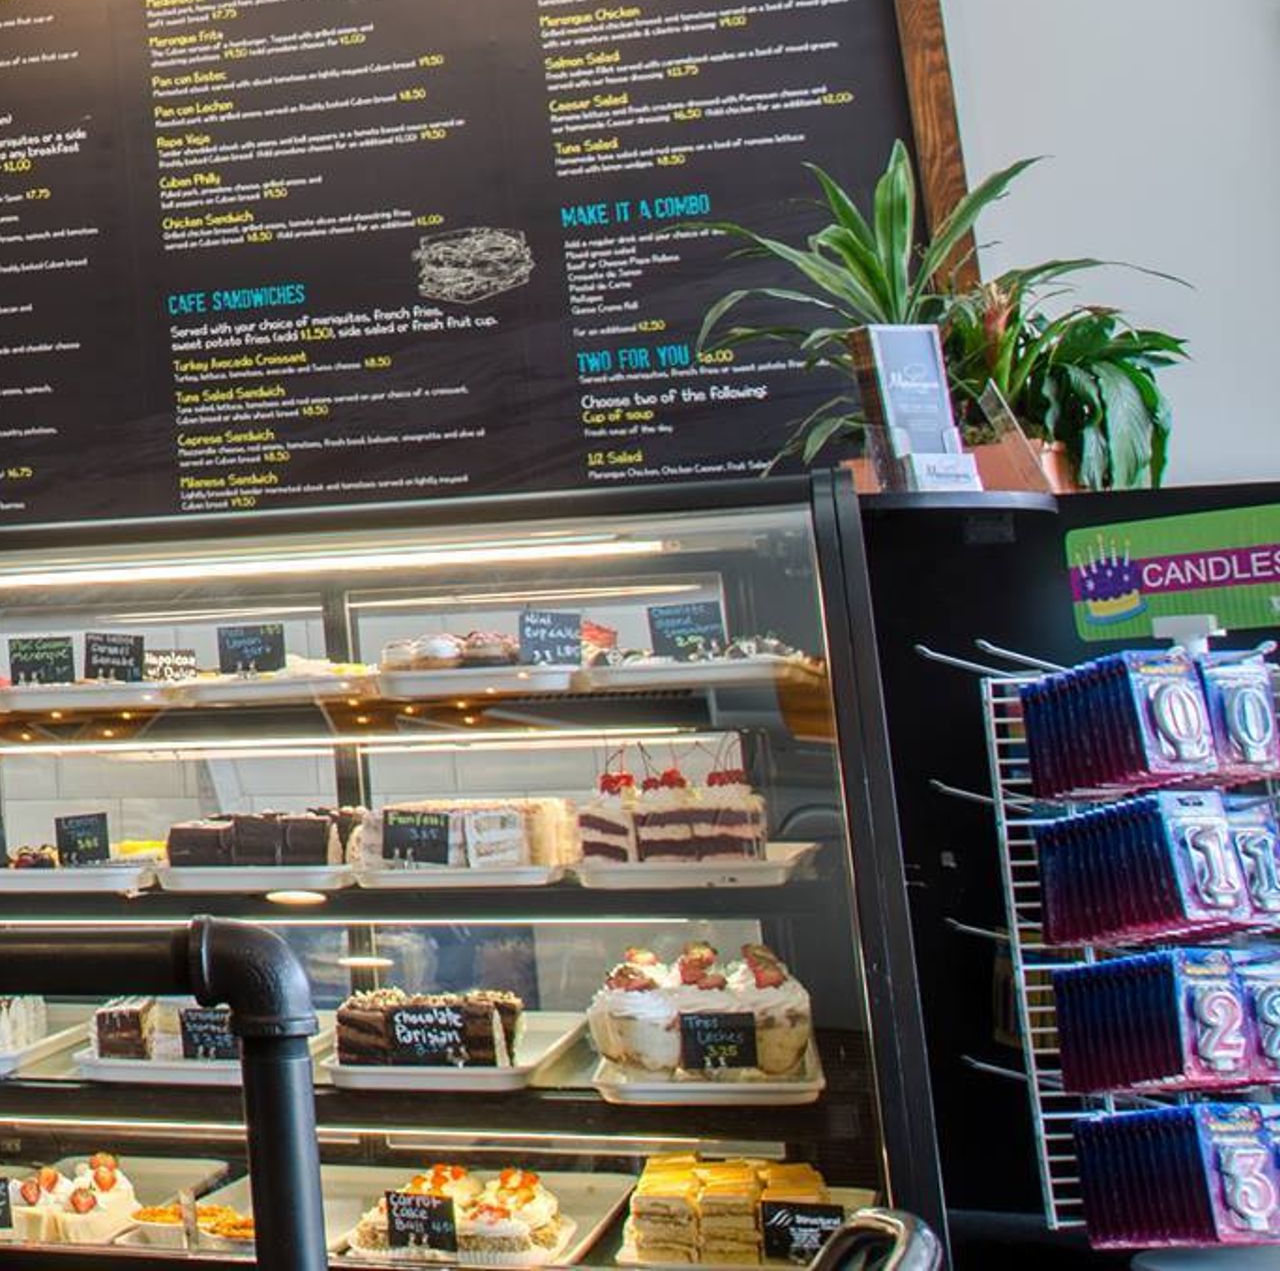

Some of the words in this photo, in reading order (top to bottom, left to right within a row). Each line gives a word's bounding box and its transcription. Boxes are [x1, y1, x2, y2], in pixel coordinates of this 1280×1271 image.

[559, 204, 608, 225] MAKE
[614, 201, 630, 221] IT
[639, 198, 652, 220] A
[654, 193, 711, 219] COMBO
[167, 292, 206, 313] CAFE
[211, 285, 305, 309] SANDWICHES
[575, 351, 612, 371] TWO
[617, 348, 650, 368] FOR
[655, 345, 689, 365] YOU
[580, 394, 631, 408] Choose
[633, 392, 658, 405] two
[659, 389, 677, 403] of
[680, 389, 706, 401] the
[708, 385, 768, 399] following:
[581, 410, 606, 423] Cup
[606, 409, 623, 421] of
[624, 409, 655, 420] soup
[1142, 552, 1280, 588] CANDLE
